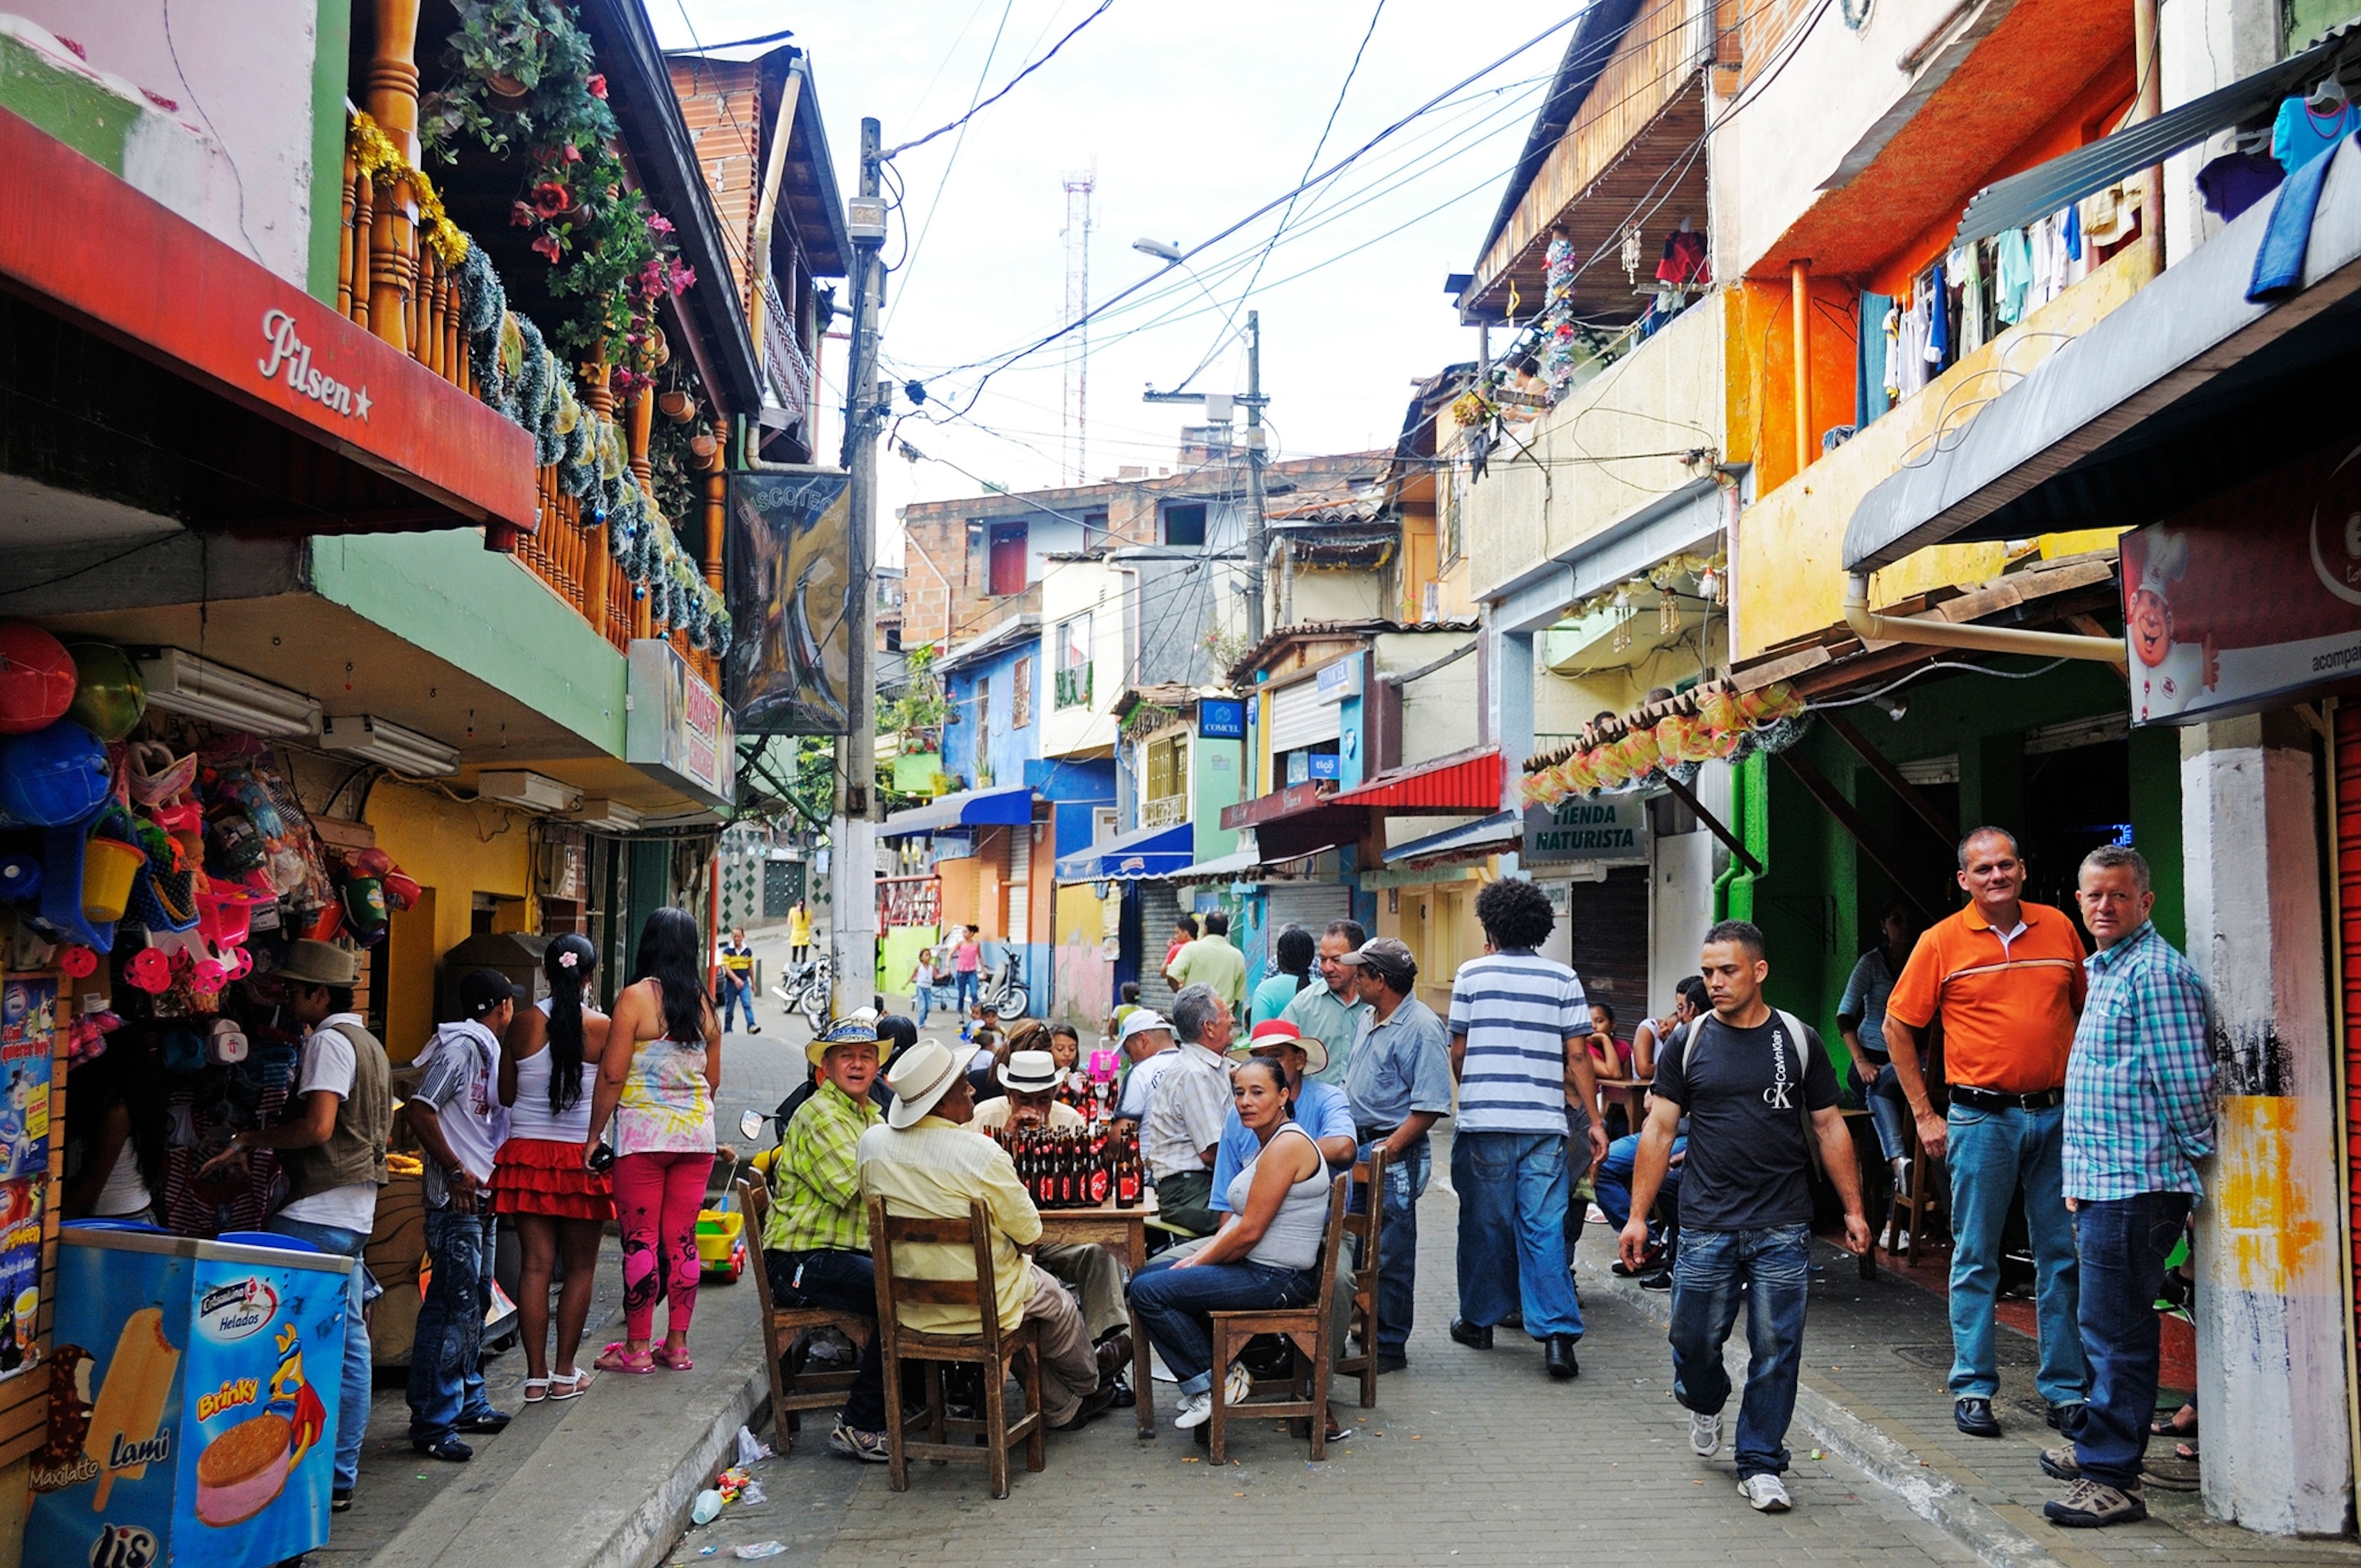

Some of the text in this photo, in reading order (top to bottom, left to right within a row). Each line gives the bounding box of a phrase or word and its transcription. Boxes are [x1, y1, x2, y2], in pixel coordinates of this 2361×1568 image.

[258, 309, 350, 415] Pilsen
[738, 486, 845, 531] DISCOTECA
[794, 701, 843, 722] BAR
[1205, 724, 1240, 733] COMCEL
[1536, 829, 1634, 850] NATURISTA
[203, 1284, 245, 1311] Colombina
[219, 1314, 259, 1331] Helados
[198, 1378, 258, 1422] Brinky
[110, 1428, 169, 1468] Lami
[29, 1458, 99, 1490] Maxilatto
